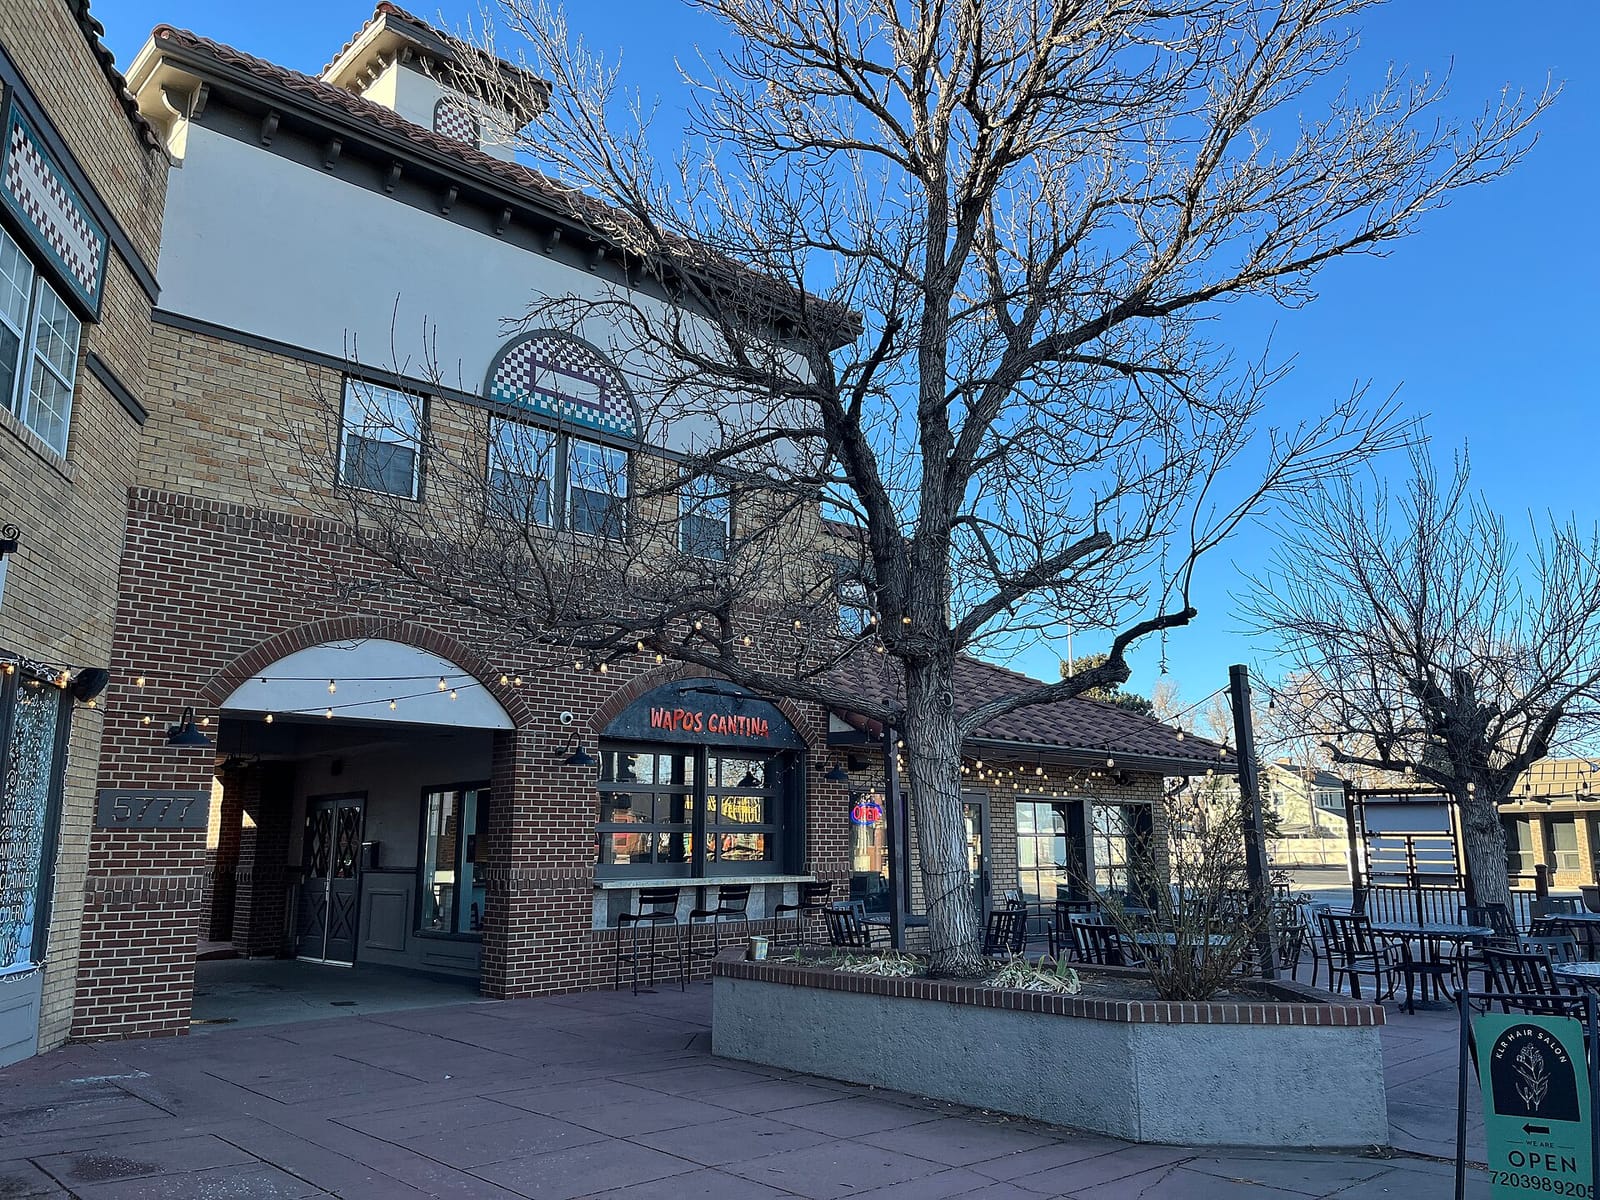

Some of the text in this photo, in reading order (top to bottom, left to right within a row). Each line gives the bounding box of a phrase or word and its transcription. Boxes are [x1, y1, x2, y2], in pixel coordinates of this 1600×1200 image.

[651, 707, 769, 737] WAPOS CANTINA
[16, 780, 29, 796] ART
[5, 810, 35, 827] VINTAGE
[112, 796, 195, 822] 5777
[1495, 1029, 1567, 1063] KLR HAIR SALON
[1540, 1141, 1554, 1149] ARE
[1508, 1150, 1577, 1174] OPEN
